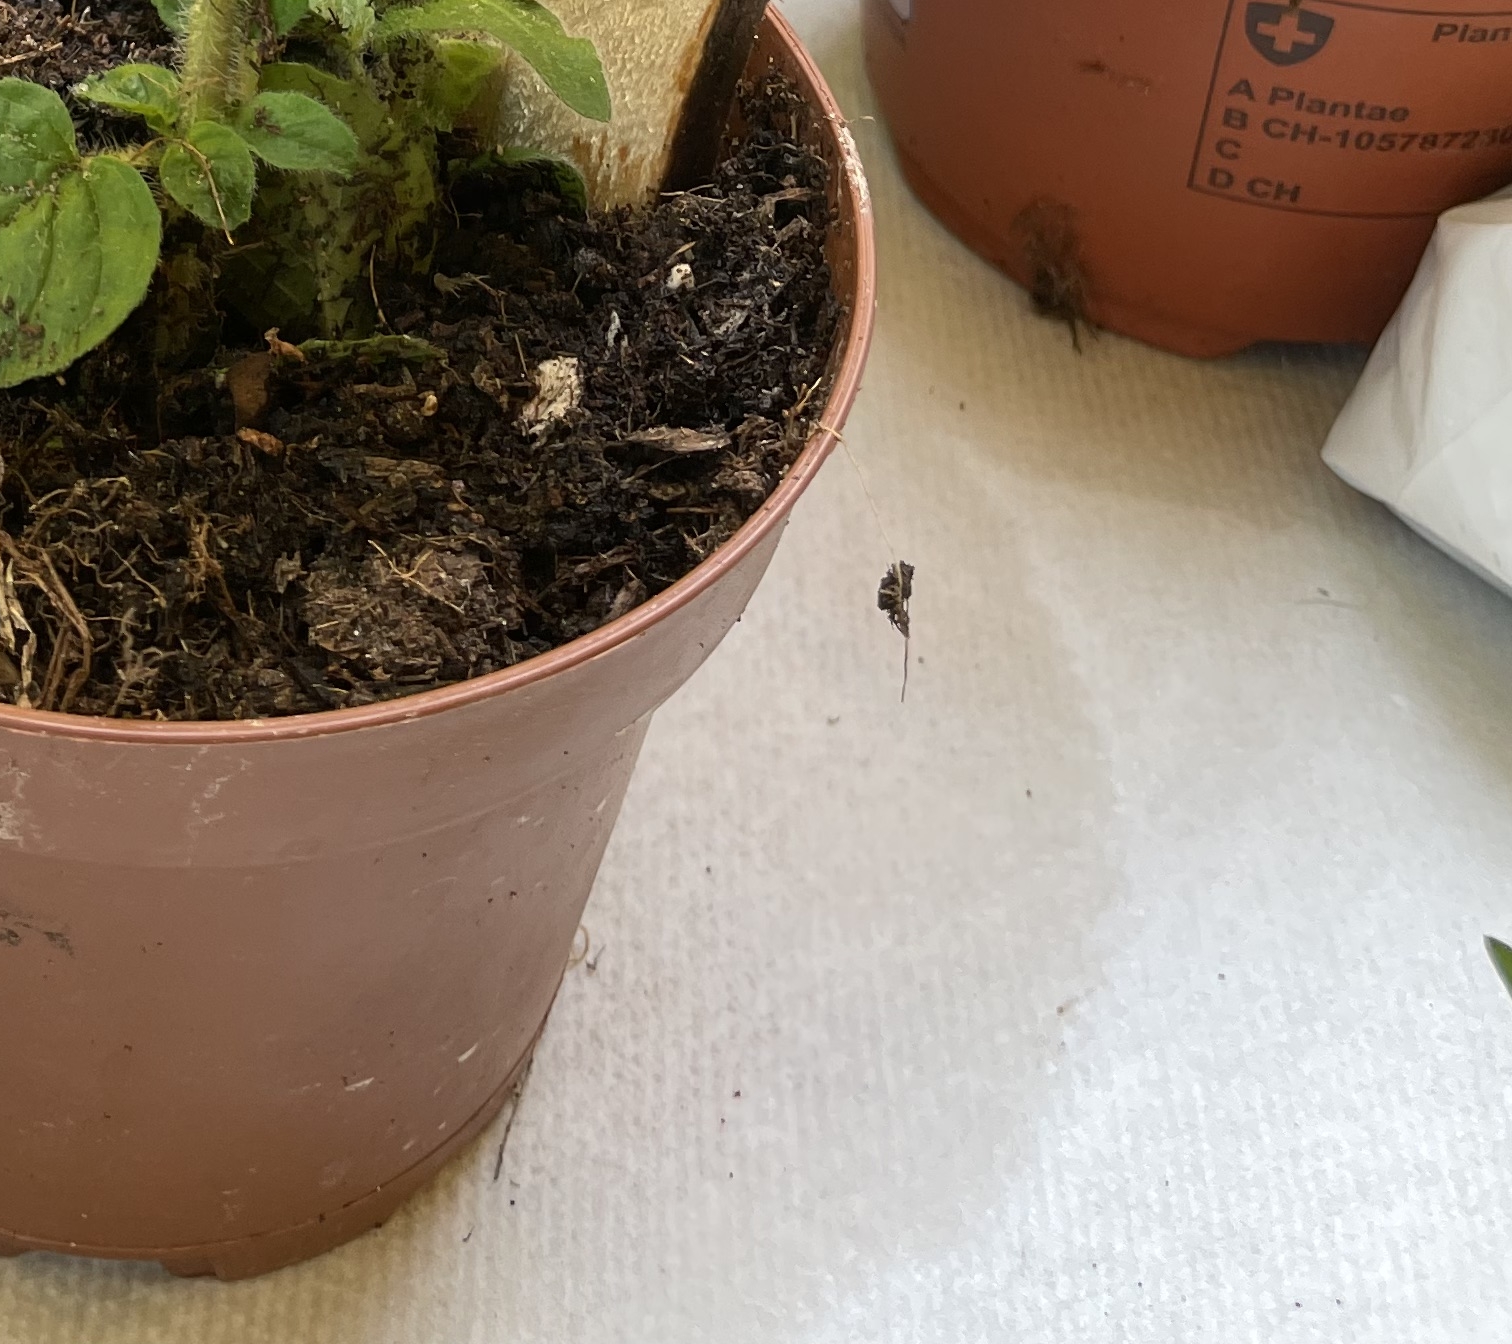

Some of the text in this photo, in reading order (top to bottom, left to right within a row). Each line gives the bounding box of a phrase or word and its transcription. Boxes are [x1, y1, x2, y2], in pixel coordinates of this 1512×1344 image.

[1226, 78, 1410, 123] A Plantae
[1221, 107, 1249, 131] B
[1214, 137, 1243, 161] C
[1207, 167, 1302, 204] D CH
